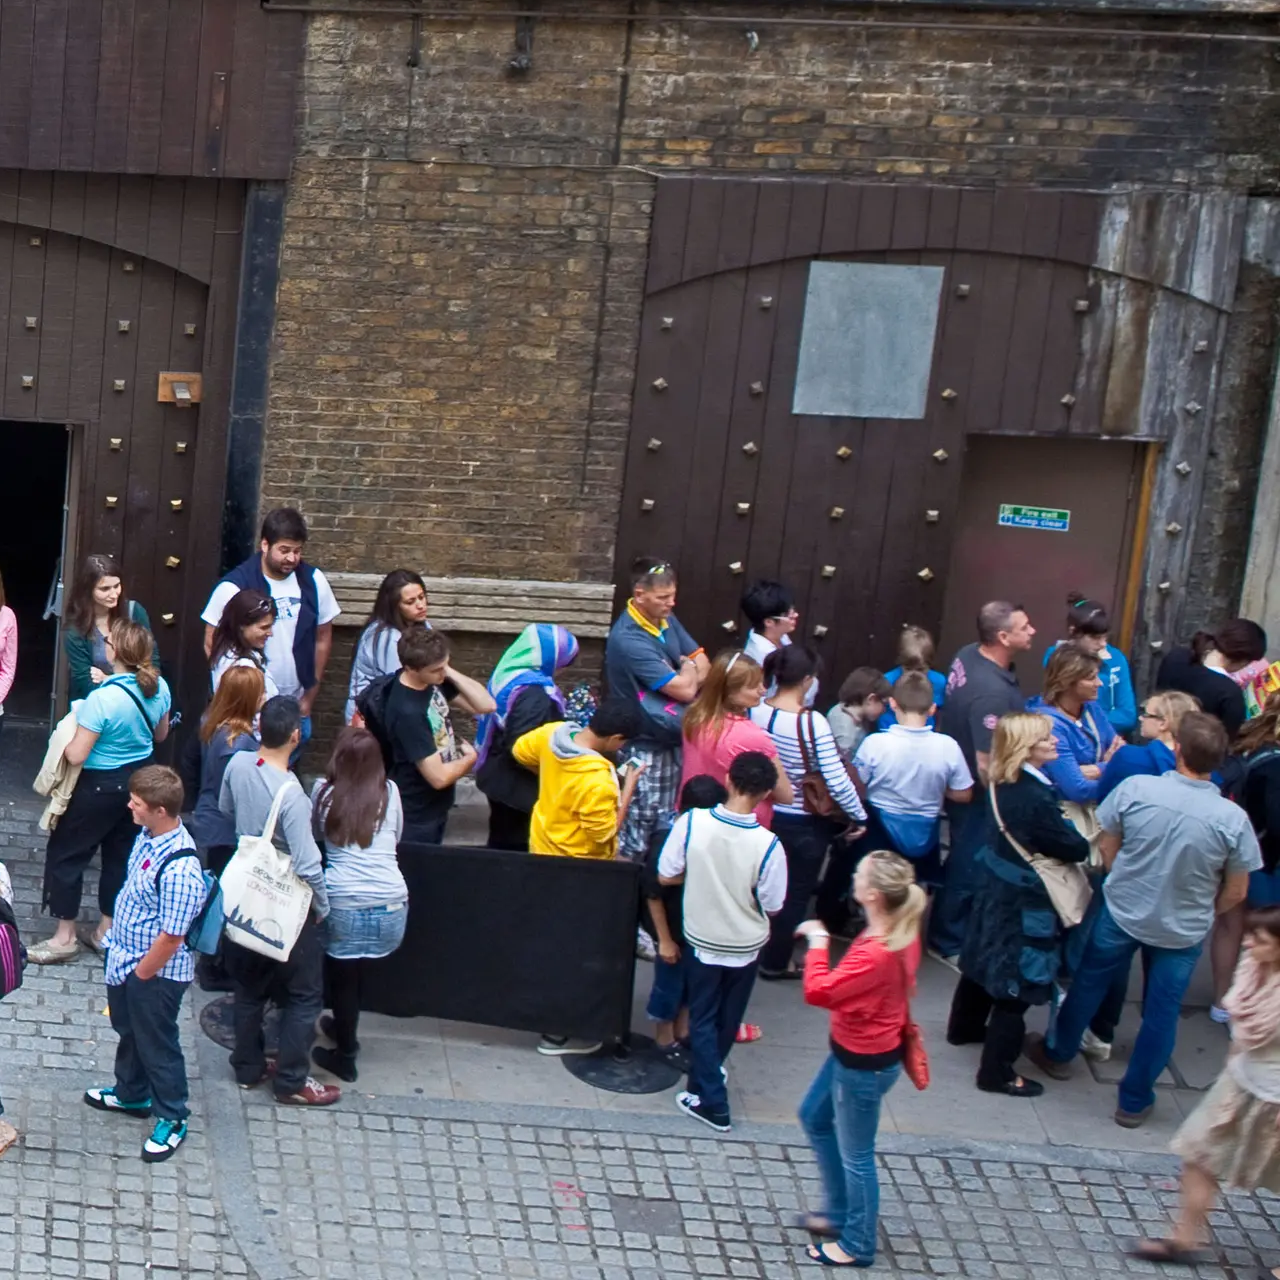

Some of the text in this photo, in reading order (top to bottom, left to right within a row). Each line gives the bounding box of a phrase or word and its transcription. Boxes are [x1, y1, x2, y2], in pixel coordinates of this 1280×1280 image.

[1022, 508, 1039, 518] Fire
[1015, 516, 1064, 528] Keep clear
